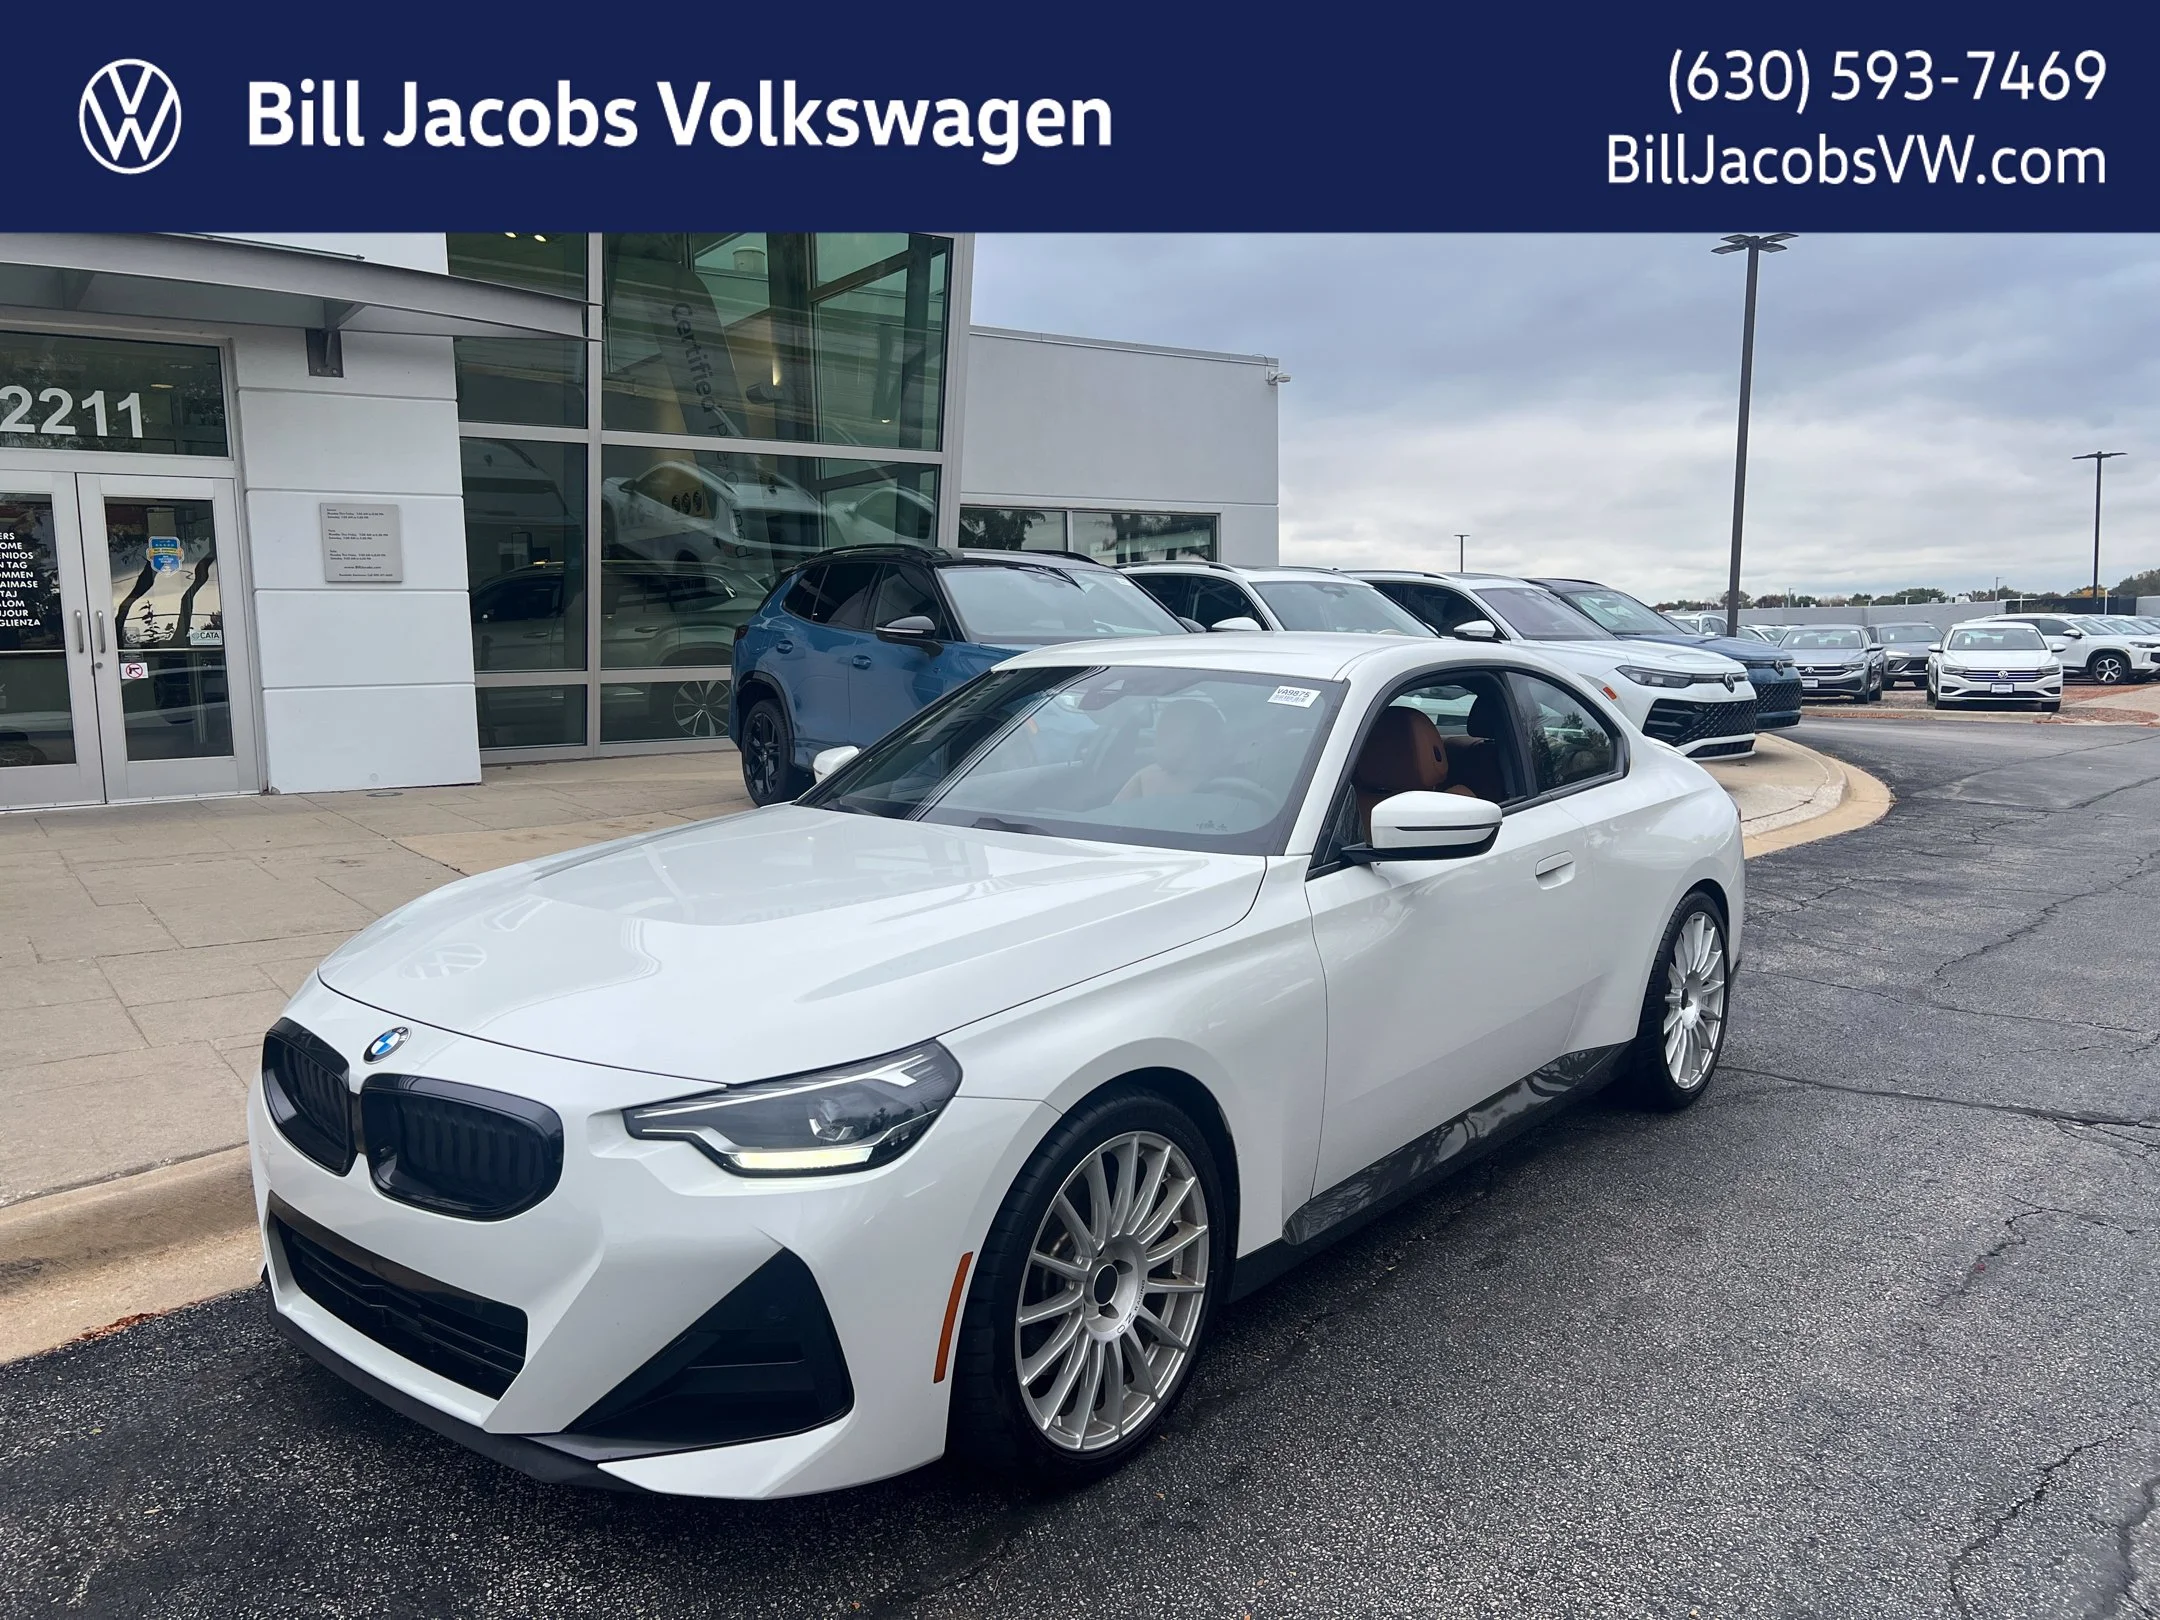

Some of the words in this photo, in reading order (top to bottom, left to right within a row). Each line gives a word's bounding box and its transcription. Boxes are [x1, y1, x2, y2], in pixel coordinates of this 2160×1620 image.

[0, 385, 143, 438] 2211
[0, 542, 22, 550] OME
[0, 551, 33, 560] NIDOS
[6, 561, 28, 569] TAG
[0, 571, 33, 579] MMEN
[0, 580, 38, 588] AIMASE
[0, 590, 17, 598] TAJ
[0, 600, 25, 608] LOM
[0, 609, 28, 617] JOUR
[0, 619, 40, 627] GLIENZA
[200, 632, 220, 640] CATA
